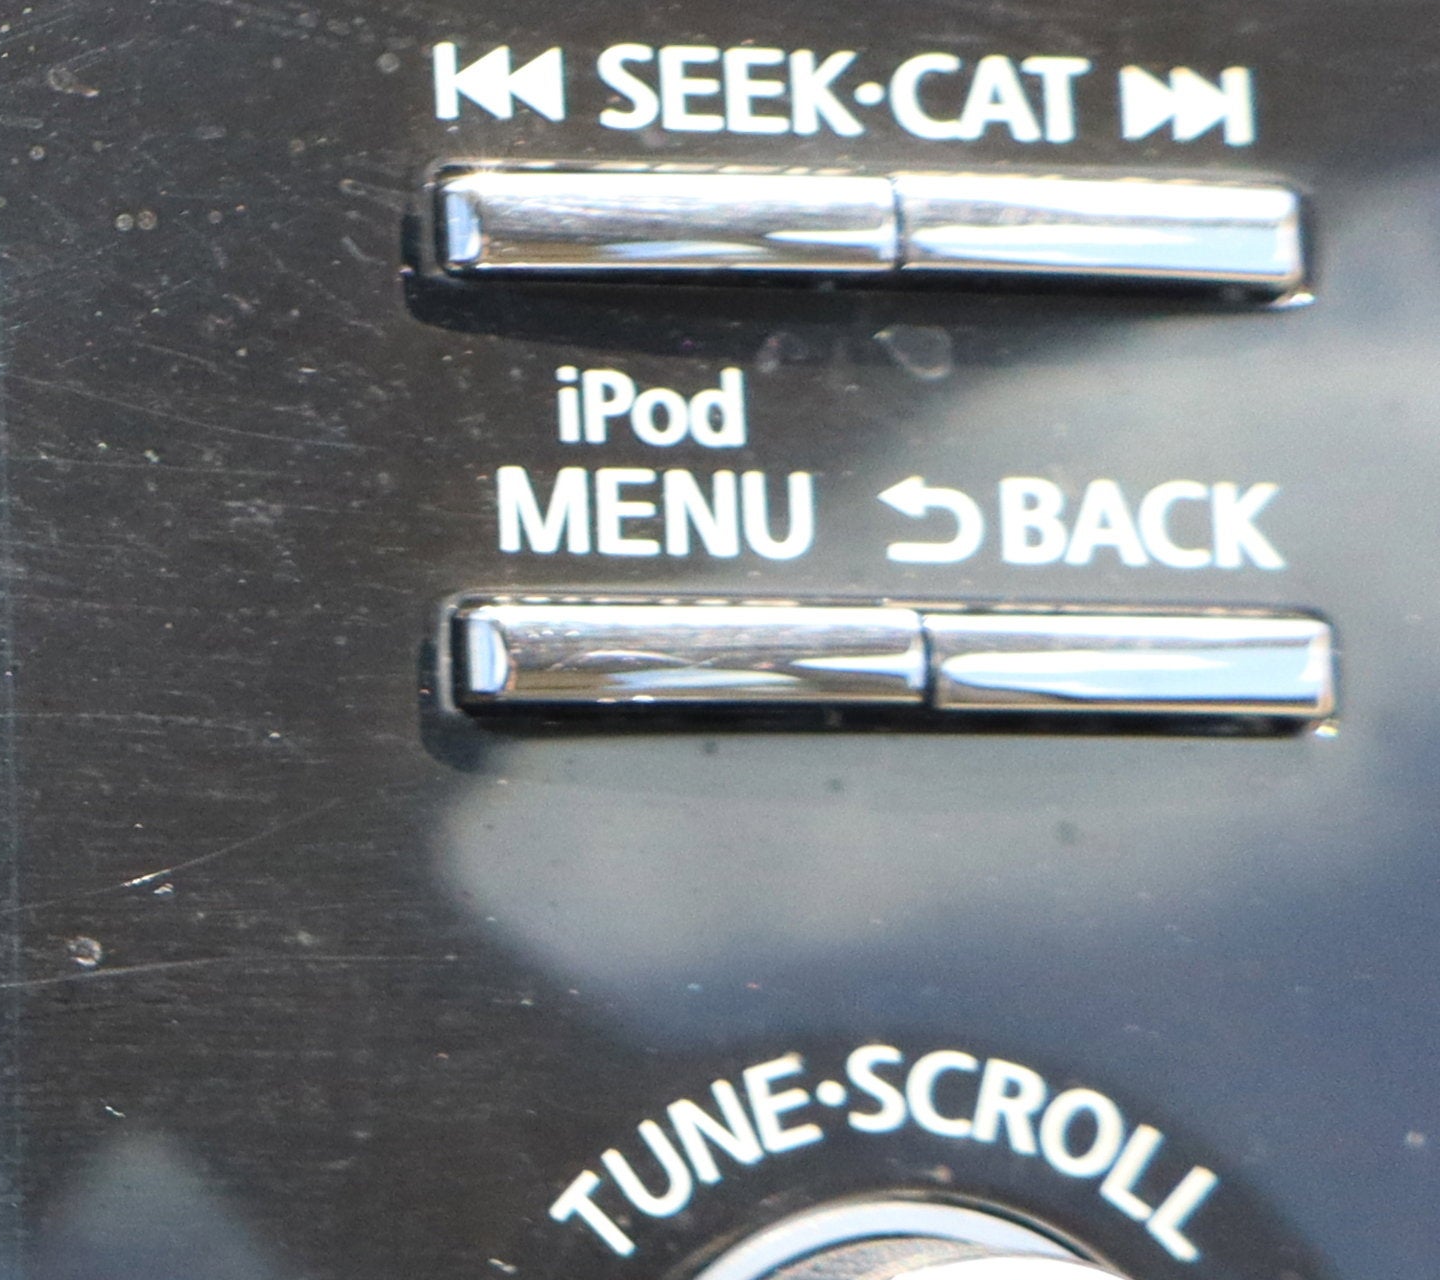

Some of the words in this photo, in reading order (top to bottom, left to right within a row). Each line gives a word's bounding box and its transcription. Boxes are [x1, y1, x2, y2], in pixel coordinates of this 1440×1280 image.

[556, 366, 747, 449] iPod
[496, 466, 814, 560] MENU
[998, 477, 1286, 569] BACK
